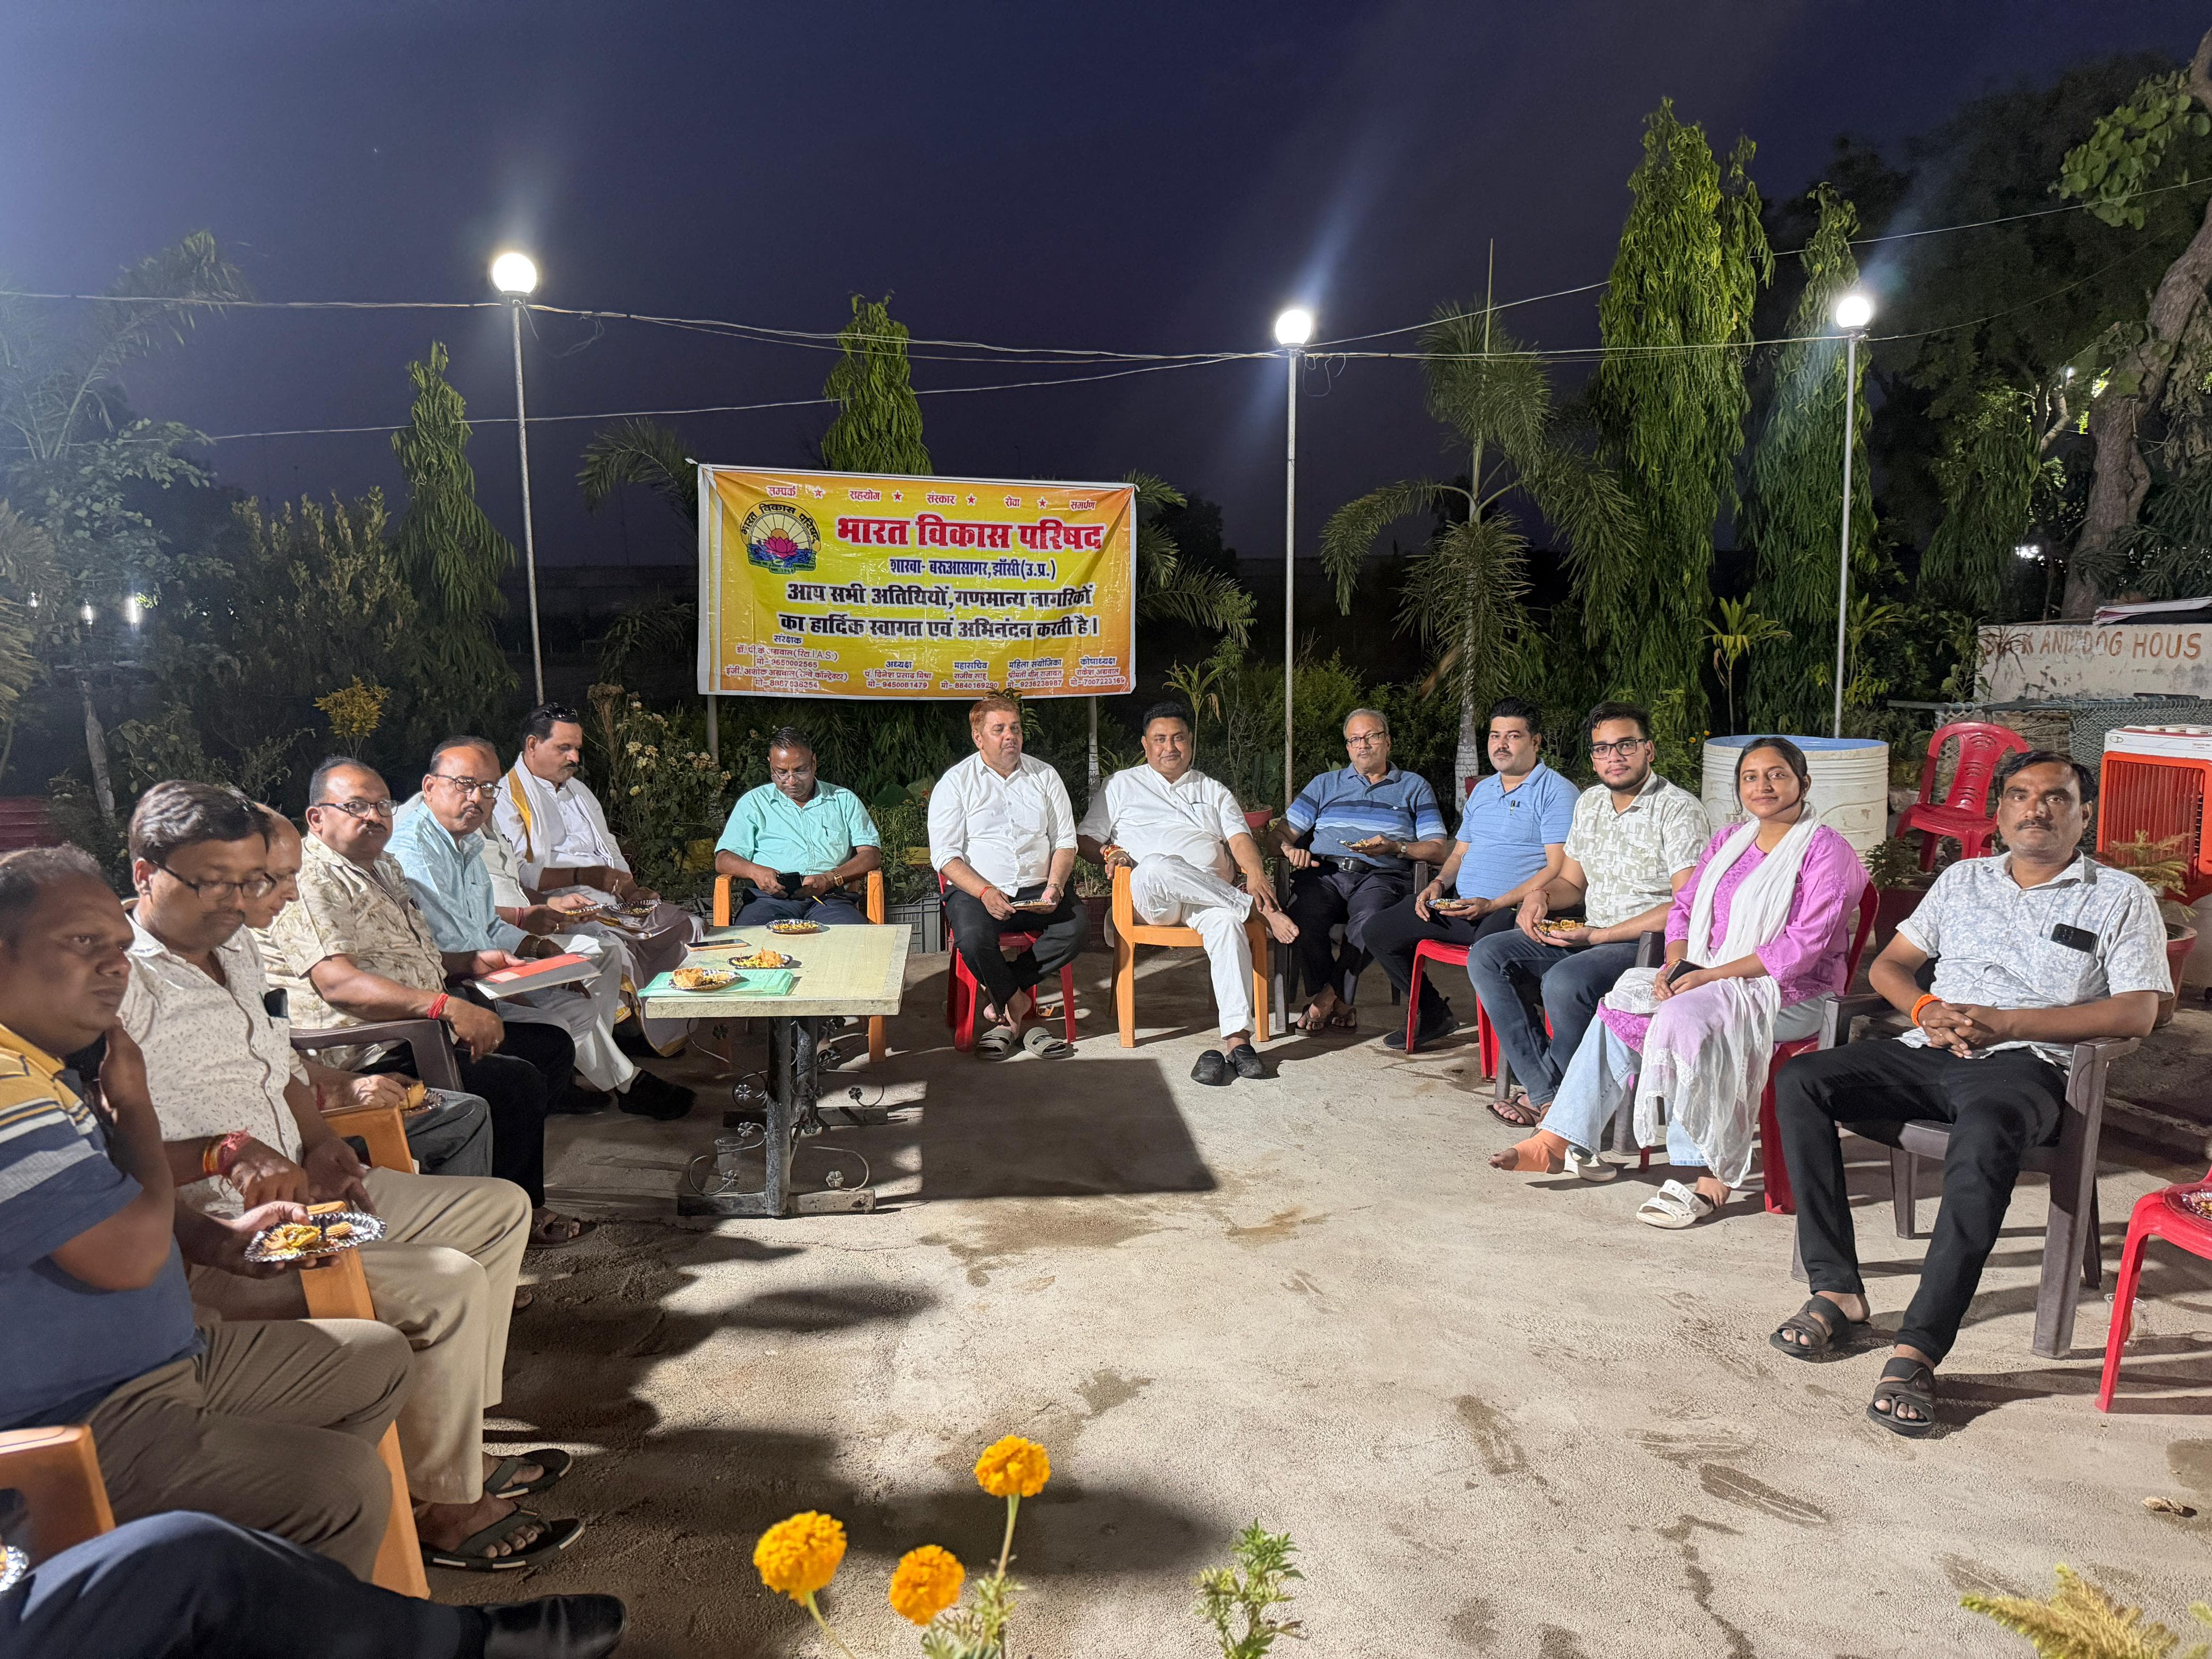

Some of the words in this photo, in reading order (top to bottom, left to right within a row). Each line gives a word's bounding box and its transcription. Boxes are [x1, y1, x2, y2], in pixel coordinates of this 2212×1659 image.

[767, 485, 797, 497] सम्पर्क
[849, 489, 881, 501] सहयोग
[927, 492, 956, 504] संस्कार
[1070, 500, 1096, 510] समर्पण
[741, 512, 757, 535] भारत
[759, 504, 796, 514] विकास
[838, 518, 910, 545] भारत
[916, 514, 1013, 548] विकास
[1018, 519, 1104, 550] परिषद
[788, 584, 826, 601] आप
[830, 584, 866, 604] सभी
[1029, 585, 1093, 607] नागरिकों
[779, 614, 806, 631] का
[809, 614, 865, 634] हार्दिक
[869, 620, 923, 636] स्वागत
[926, 617, 954, 637] एवं
[958, 618, 1033, 638] अभिनंदन
[1037, 617, 1073, 636] करती
[774, 634, 802, 644] संरक्षक
[2039, 631, 2073, 655] AND
[2132, 632, 2201, 660] HOUS
[954, 660, 987, 669] महासचिव
[1009, 659, 1028, 668] महिला
[1080, 657, 1116, 665] कोषाध्यक्ष
[744, 666, 767, 675] अशोक
[917, 671, 931, 679] मिश्रा
[1076, 667, 1094, 676] राकेश
